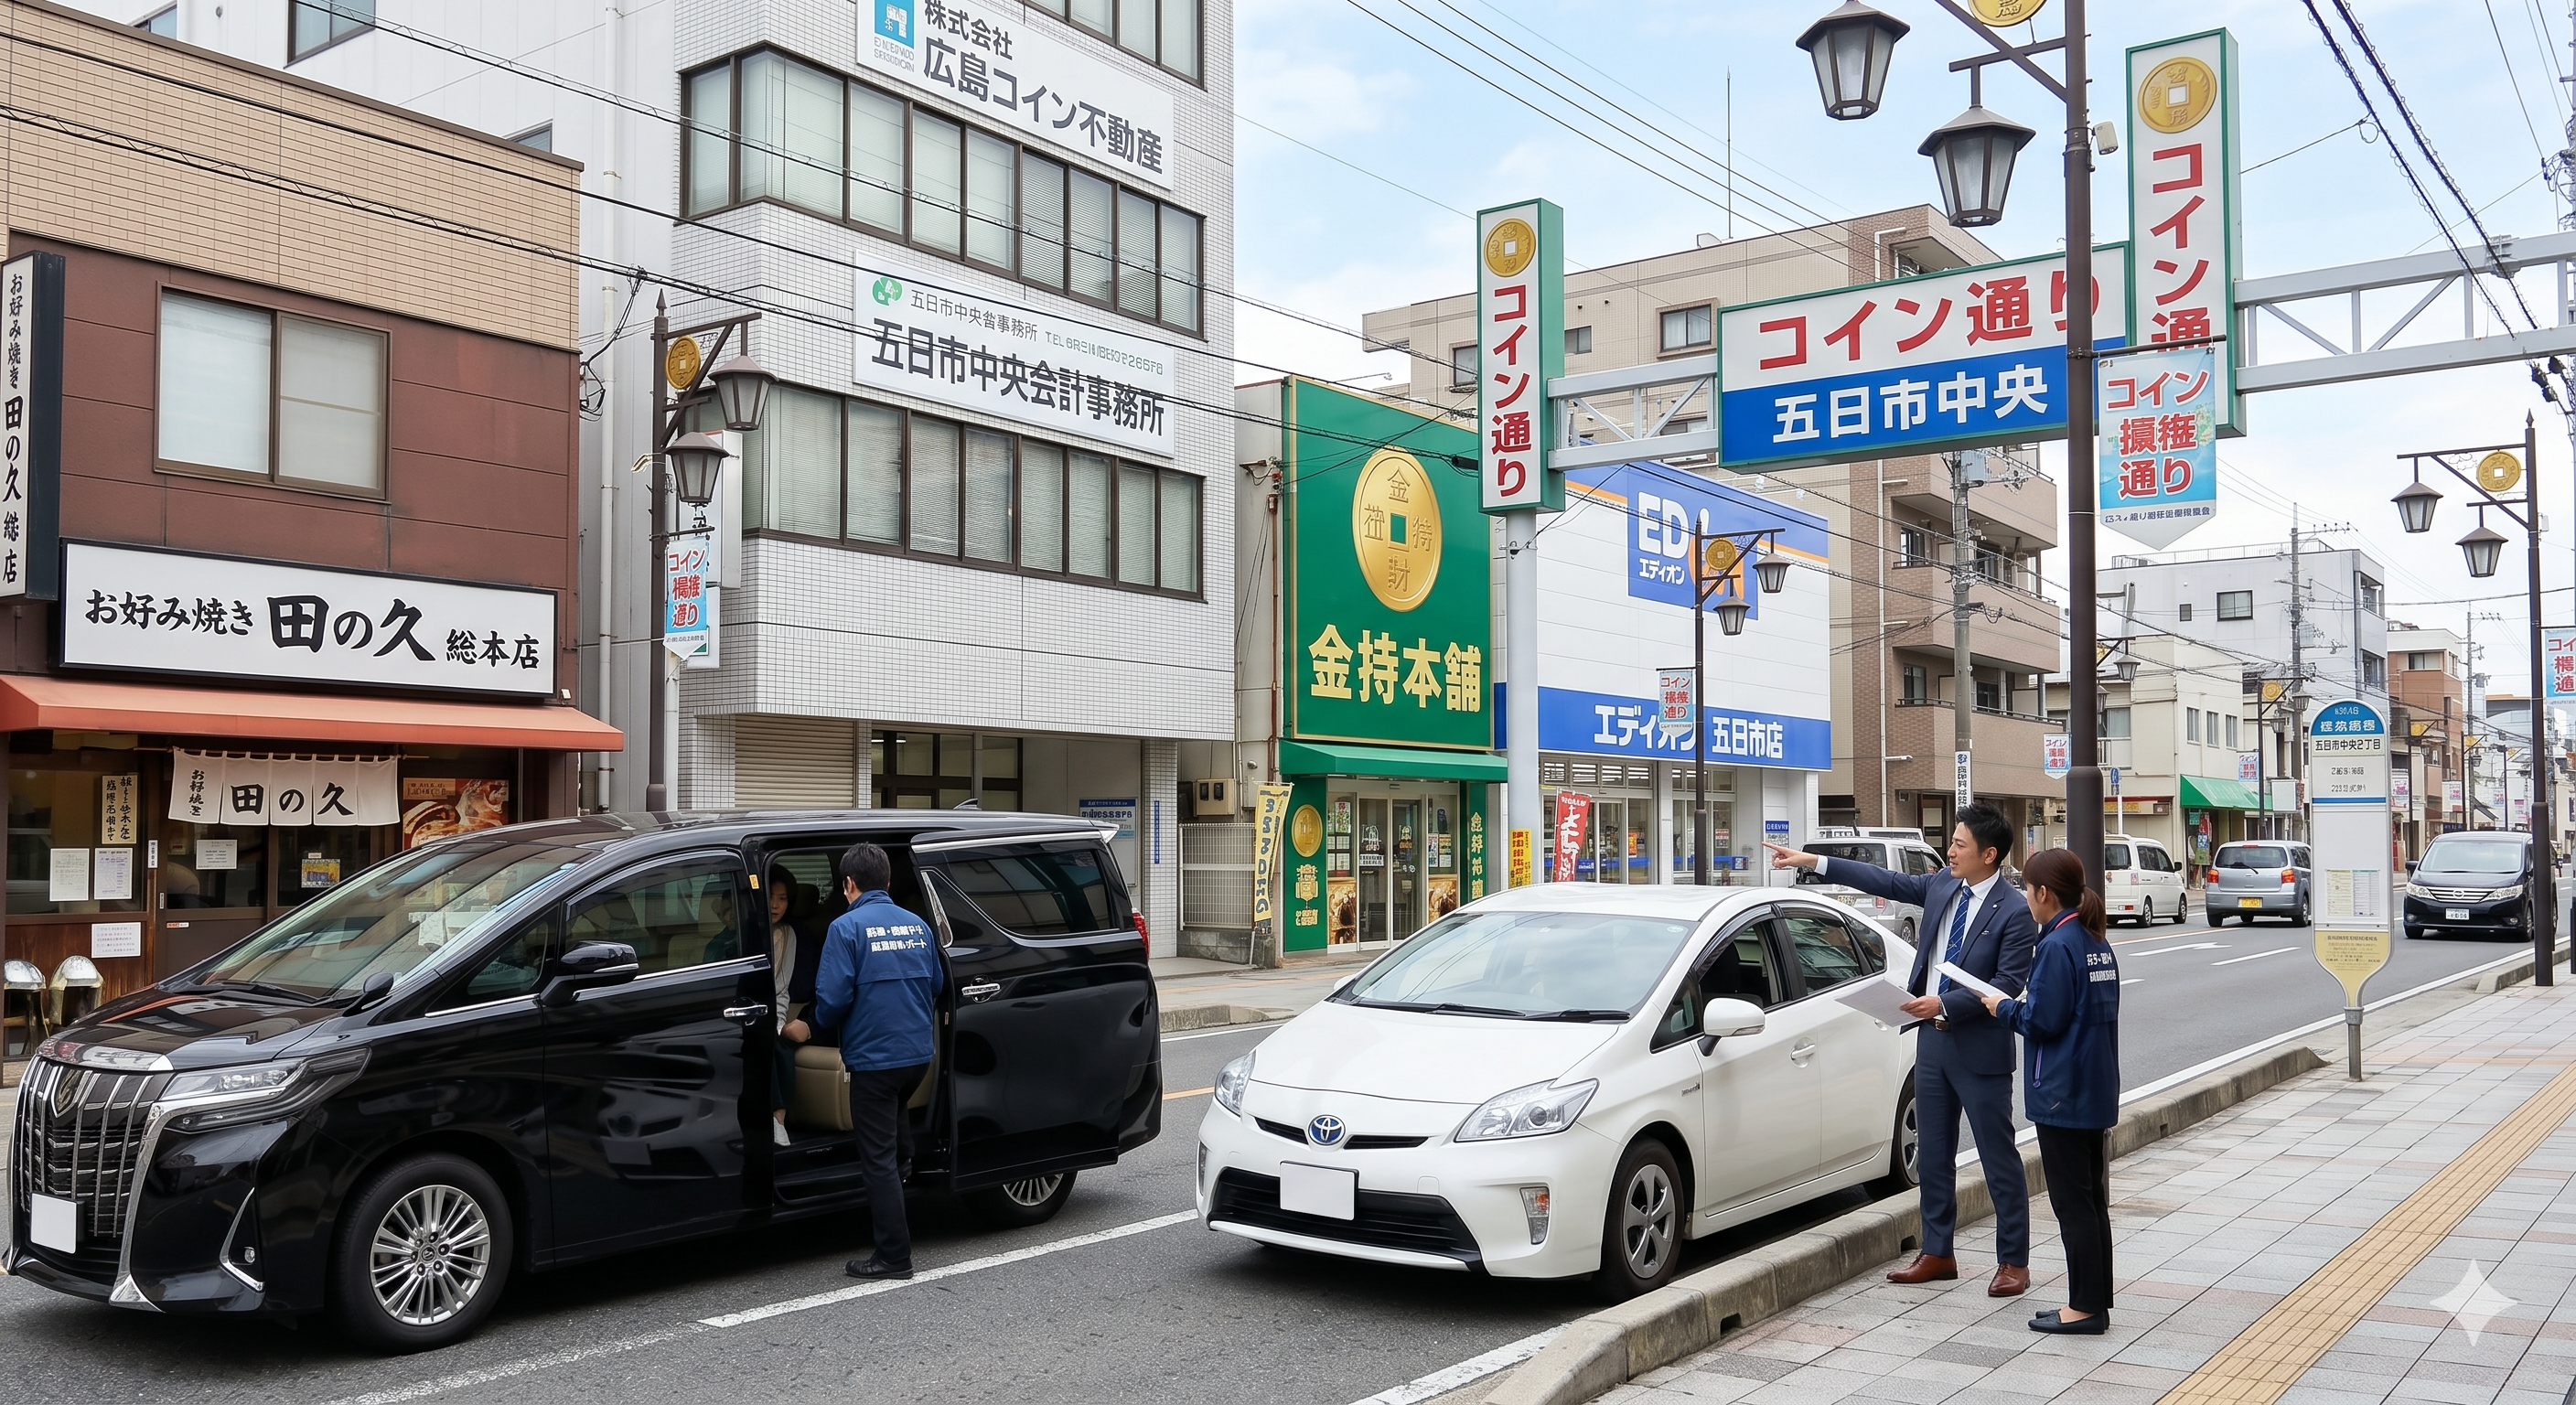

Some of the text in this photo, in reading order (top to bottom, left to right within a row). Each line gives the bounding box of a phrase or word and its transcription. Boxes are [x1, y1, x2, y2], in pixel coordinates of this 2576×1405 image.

[924, 0, 1013, 61] 株式会社
[923, 36, 1163, 175] 広島コイン不動産
[2150, 143, 2210, 351] コイン通
[9, 273, 23, 390] お好み焼き
[1759, 270, 2100, 370] コイン通り
[871, 317, 1165, 436] 五日市中央会計事務所
[1491, 284, 1532, 498] コイン通り
[1773, 363, 2048, 444] 五日市中央
[2108, 370, 2209, 409] コイン
[3, 395, 23, 503] 田の久
[2120, 457, 2192, 499] 通り
[669, 550, 705, 573] コイン
[1639, 557, 1685, 585] エディオン
[85, 588, 540, 670] お好み焼き 田の久 総本店
[1308, 623, 1482, 713] 金持本舗
[2548, 638, 2576, 652] コイ
[1660, 677, 1690, 688] コイン
[1712, 716, 1783, 759] 五日市店
[231, 781, 355, 816] 田の久
